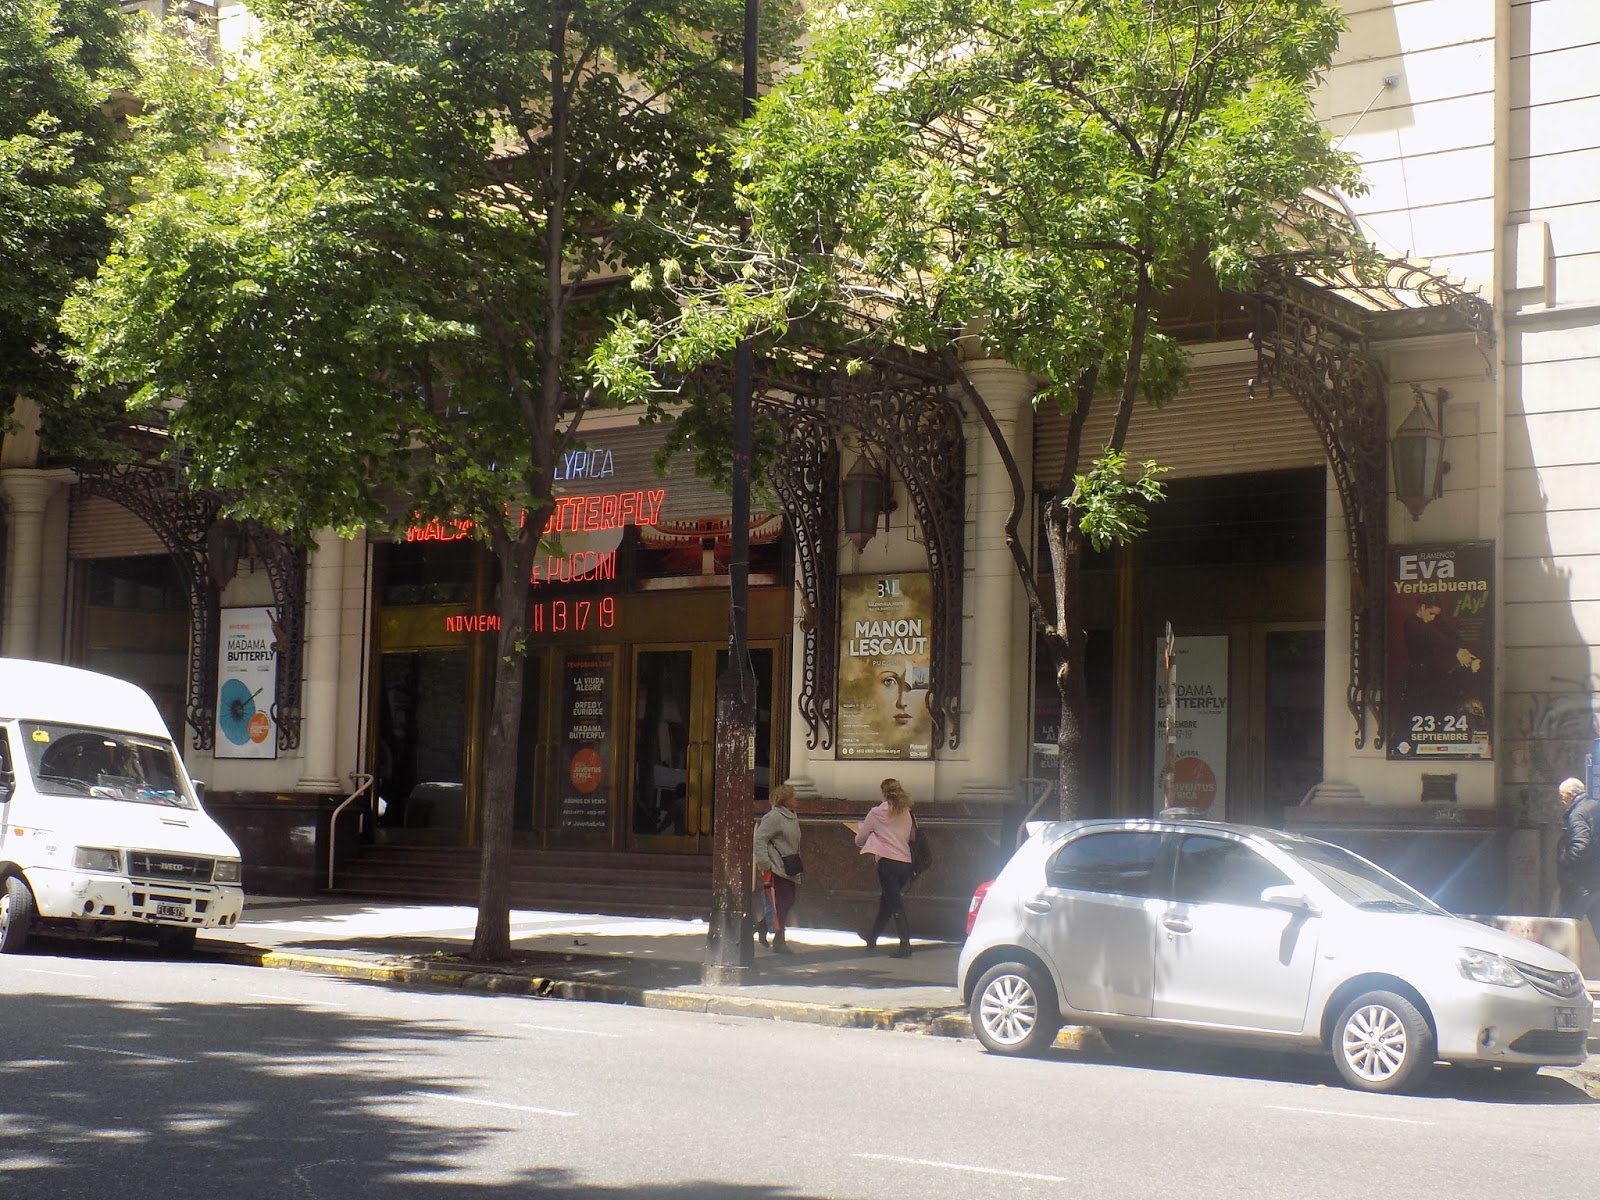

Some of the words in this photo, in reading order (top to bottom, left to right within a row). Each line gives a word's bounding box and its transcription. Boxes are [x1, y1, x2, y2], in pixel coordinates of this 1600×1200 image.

[1420, 551, 1455, 559] FLAMENCO
[547, 551, 617, 584] PUCCINI
[1400, 555, 1455, 580] Eva
[1394, 579, 1487, 594] Yerbabuena
[446, 615, 501, 632] NOVIEM
[534, 604, 544, 632] 11
[552, 600, 567, 632] 13
[575, 602, 590, 631] 17
[600, 597, 614, 628] 19
[855, 619, 922, 638] MANON
[227, 639, 266, 651] MADAMA
[849, 637, 928, 656] LESCAUT
[227, 651, 275, 662] BUTTERFLY
[1158, 685, 1214, 697] MDAMA
[1158, 697, 1227, 709] BTTERFLY
[1157, 720, 1198, 729] NOEMBRE
[1411, 715, 1436, 732] 23
[1443, 715, 1469, 732] 24
[569, 731, 606, 739] BUTTERFLY
[1411, 733, 1469, 741] SEPTIEMBRE
[160, 863, 184, 871] IVECO
